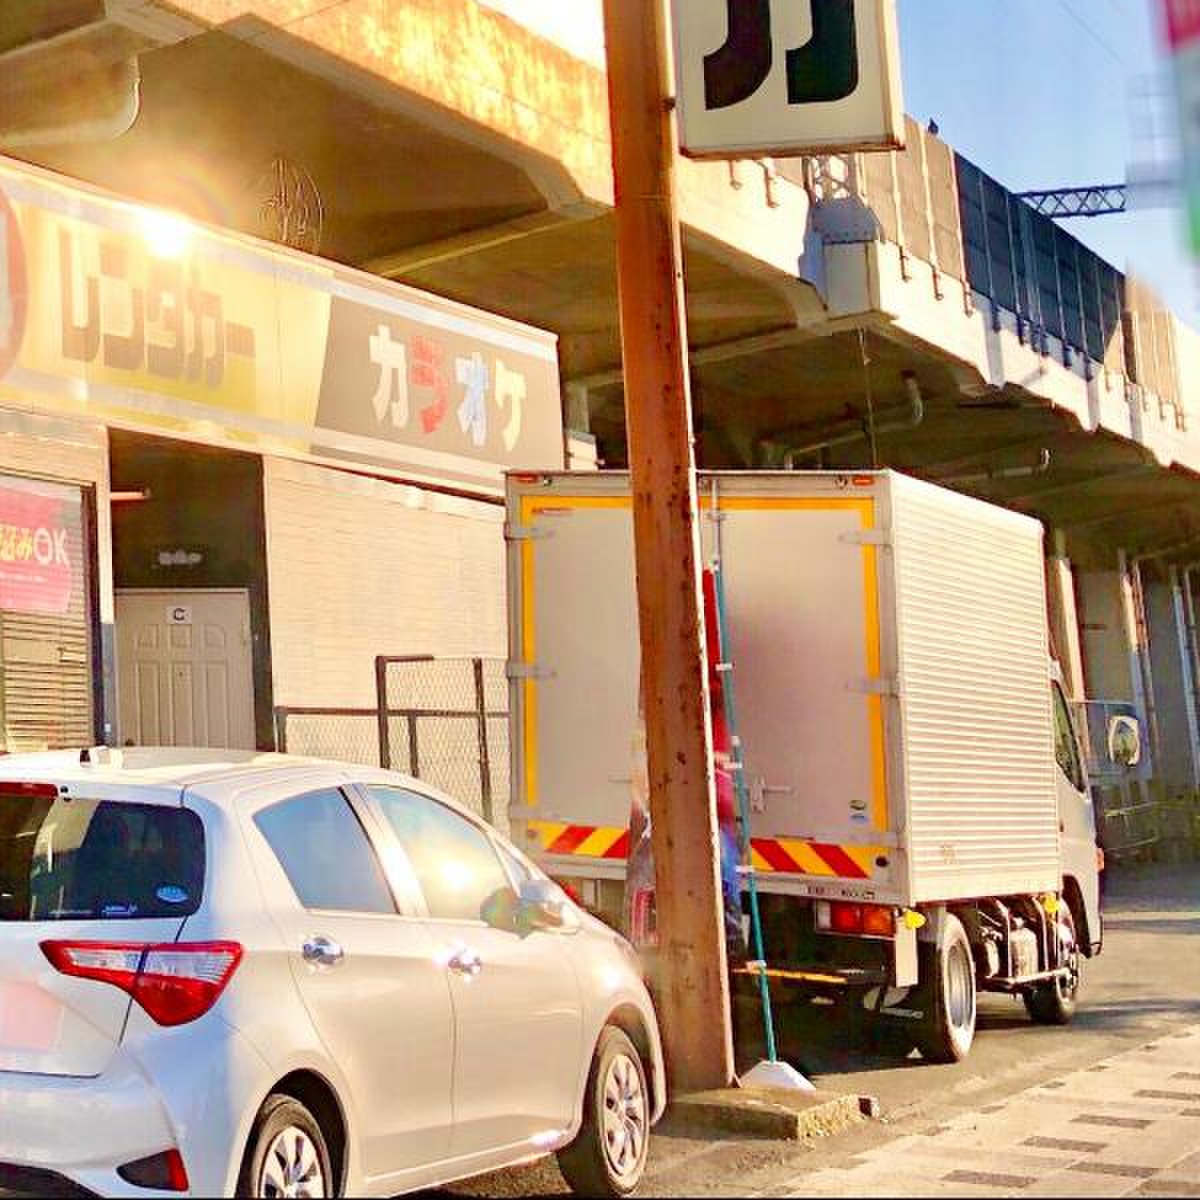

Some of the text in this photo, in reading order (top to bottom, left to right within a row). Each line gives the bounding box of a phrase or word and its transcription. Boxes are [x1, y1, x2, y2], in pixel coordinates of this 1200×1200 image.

[59, 225, 255, 389] レンタカー
[368, 324, 528, 452] カラオケ
[173, 607, 186, 621] C
